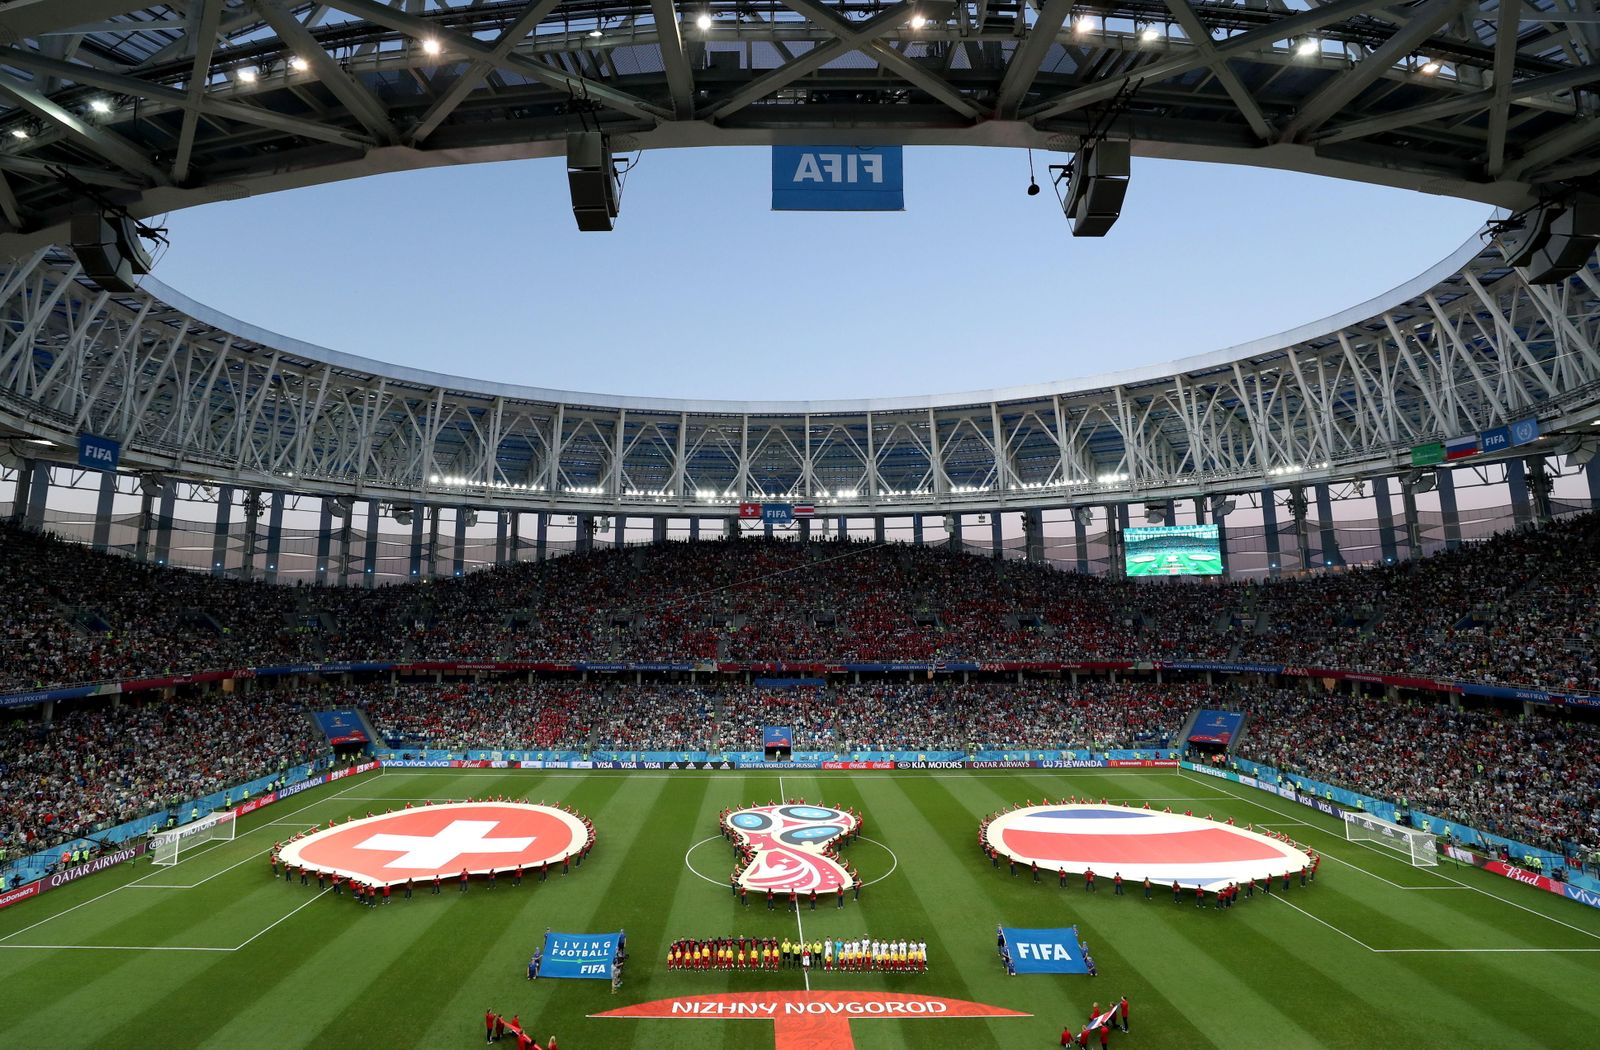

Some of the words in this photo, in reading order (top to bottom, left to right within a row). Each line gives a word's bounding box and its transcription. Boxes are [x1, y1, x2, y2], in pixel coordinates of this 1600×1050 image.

[1486, 434, 1504, 446] FIFA
[85, 445, 112, 462] FIFA
[1193, 764, 1227, 778] Hisense
[1298, 794, 1312, 807] VISA
[1317, 802, 1332, 814] VISA
[51, 865, 90, 886] QATAR
[92, 848, 135, 871] AIRWAYS
[1502, 864, 1539, 886] Bud
[554, 941, 610, 949] LIVING
[1016, 943, 1072, 960] FIFA
[552, 949, 608, 957] FOOTBALL
[580, 964, 606, 974] FIFA
[672, 1002, 778, 1014] NIZHNY
[785, 1002, 947, 1014] NOVGOROD
